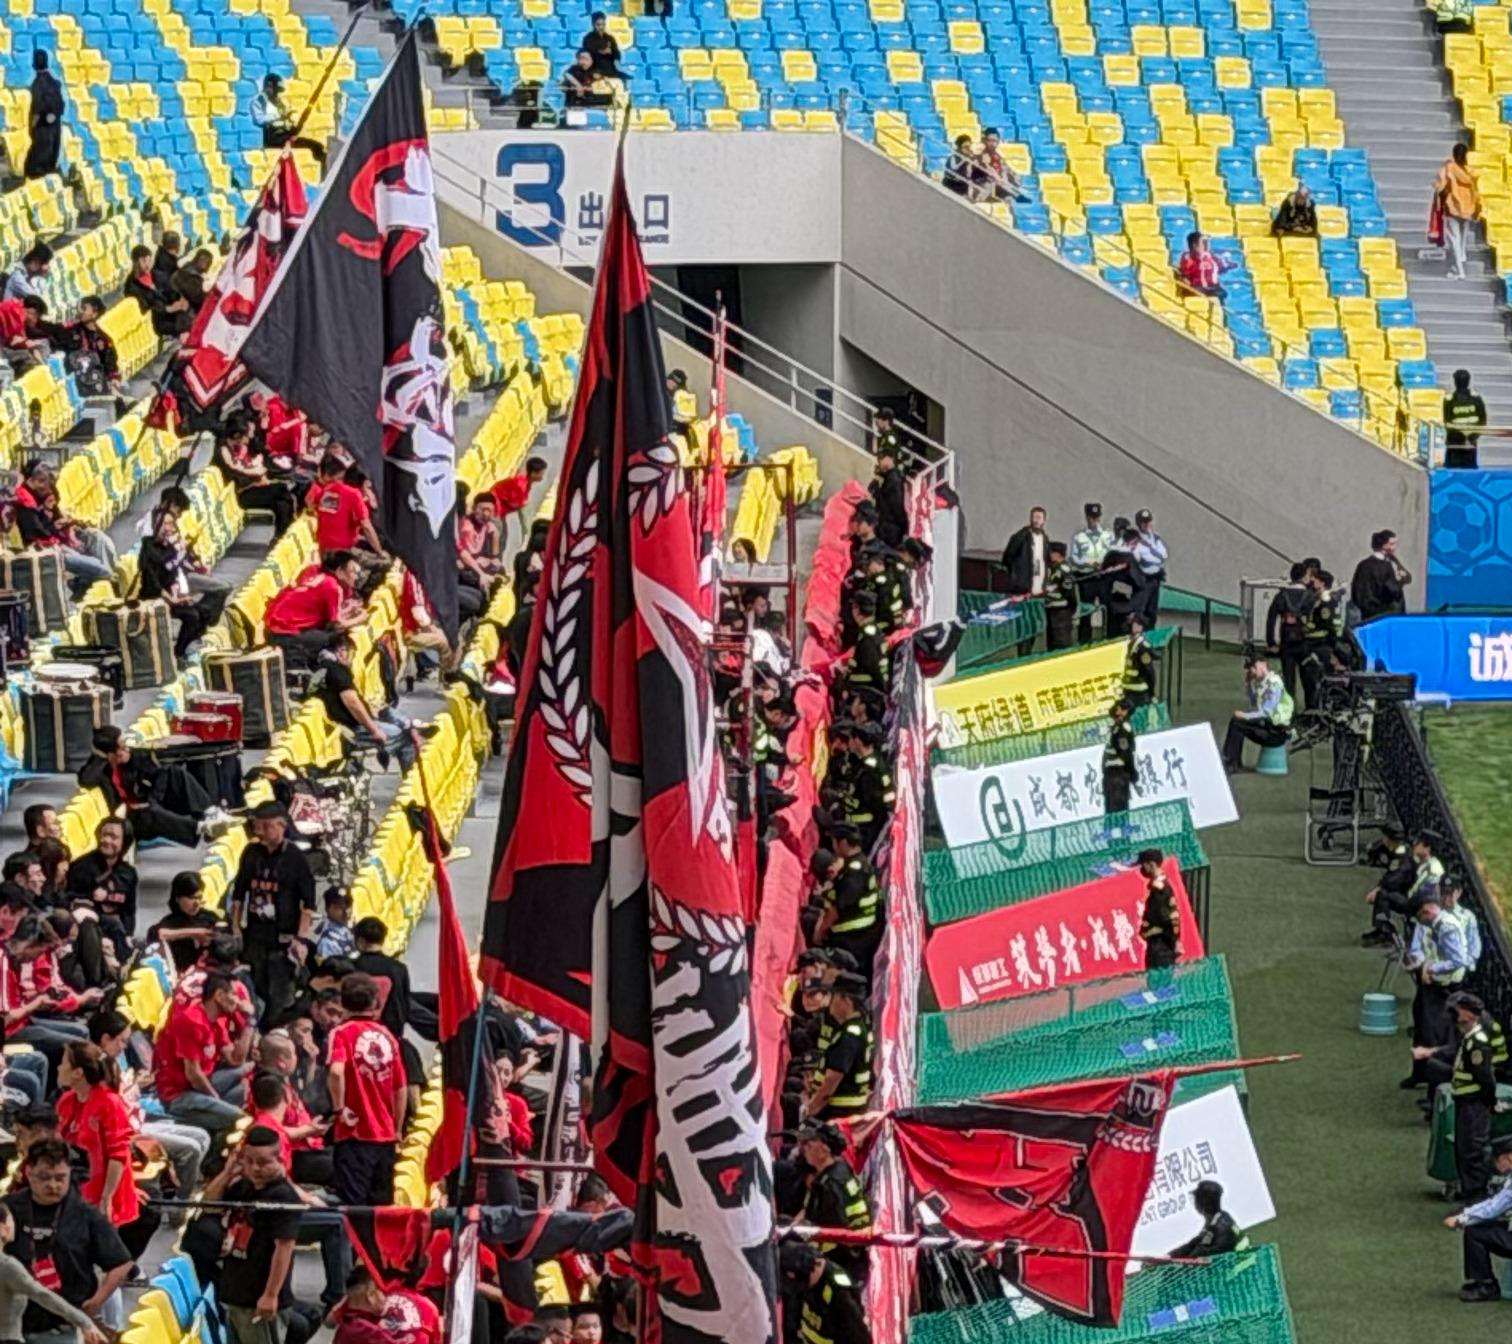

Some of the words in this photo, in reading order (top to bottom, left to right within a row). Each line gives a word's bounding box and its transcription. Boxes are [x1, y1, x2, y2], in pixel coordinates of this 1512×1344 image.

[495, 142, 566, 247] 3
[578, 191, 670, 230] 出口
[1027, 747, 1188, 820] 成都农银行
